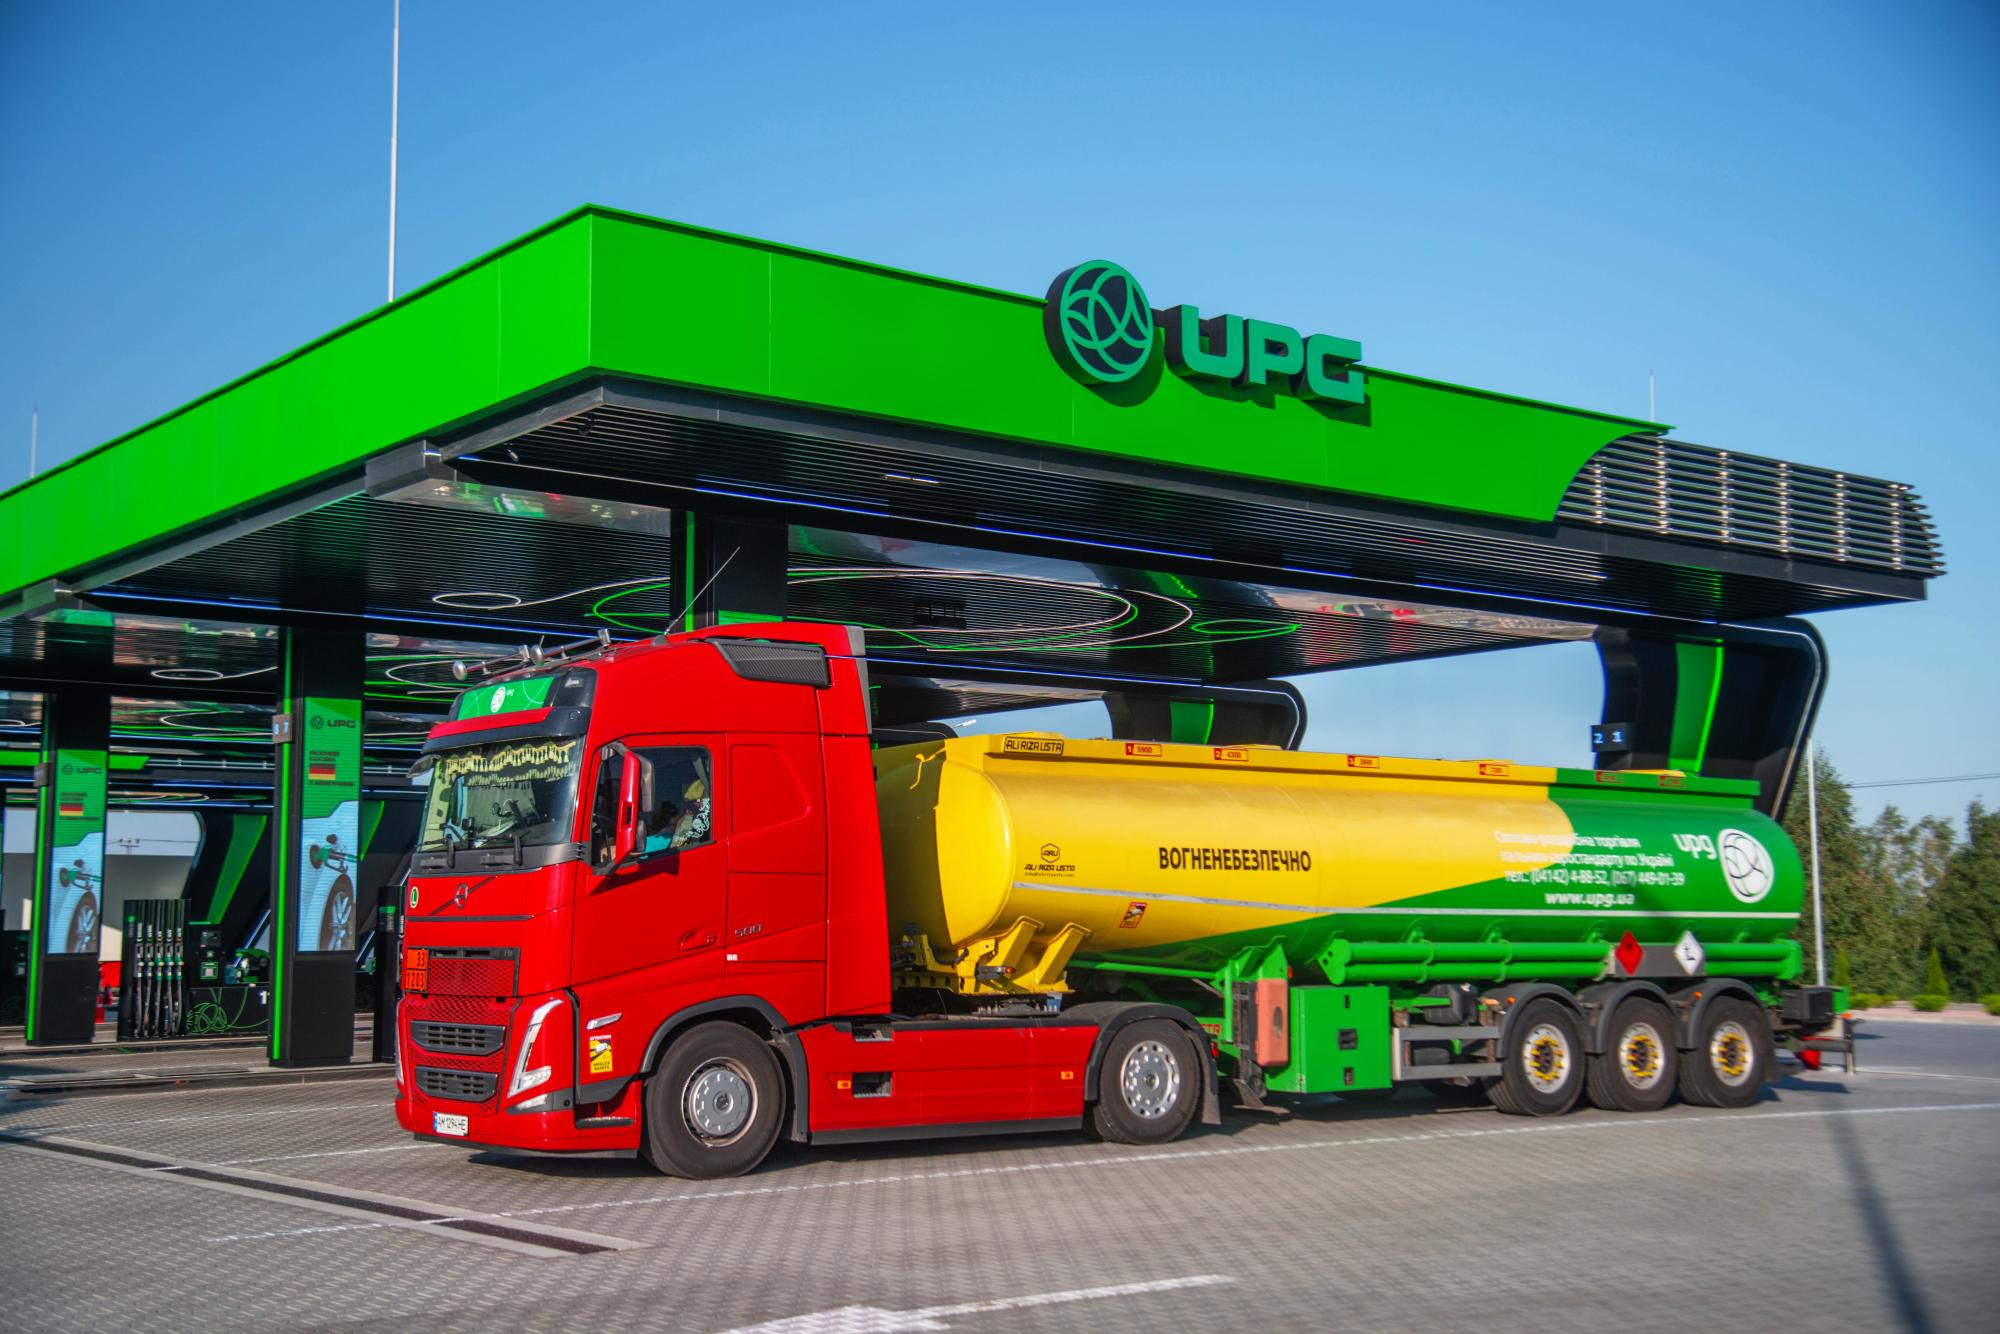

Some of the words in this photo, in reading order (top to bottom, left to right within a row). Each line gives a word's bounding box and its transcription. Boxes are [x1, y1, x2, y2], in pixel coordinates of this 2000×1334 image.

[1166, 304, 1366, 406] UPG
[327, 719, 356, 728] UPG
[1593, 733, 1604, 743] 2
[1611, 731, 1623, 742] 1
[1006, 739, 1020, 750] ALI
[1020, 740, 1040, 751] RIZA
[1040, 741, 1063, 752] USTA
[1672, 833, 1718, 860] upg
[1158, 847, 1312, 872] ВОГНЕНЕБЕЗПЕЧНО
[1543, 893, 1636, 907] www.upg.ua
[735, 924, 762, 937] 500
[416, 951, 425, 967] 33
[406, 971, 425, 988] 1203
